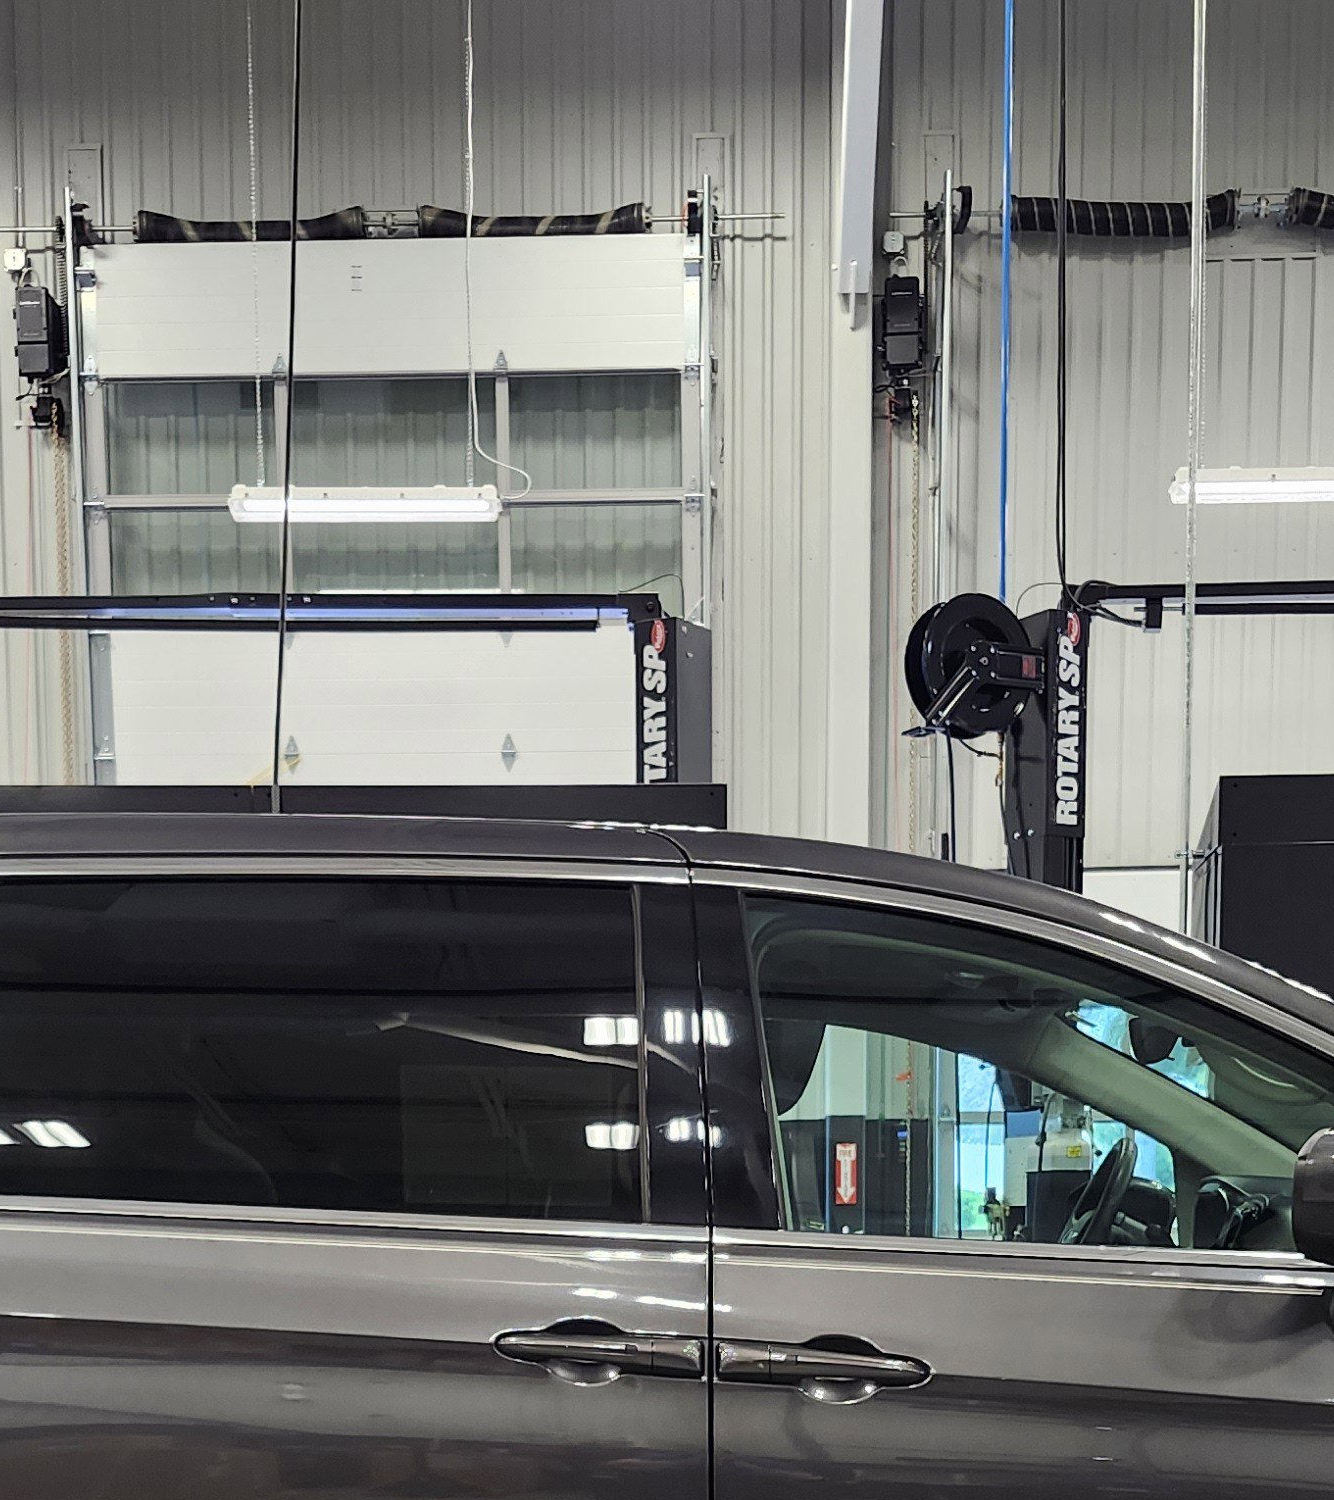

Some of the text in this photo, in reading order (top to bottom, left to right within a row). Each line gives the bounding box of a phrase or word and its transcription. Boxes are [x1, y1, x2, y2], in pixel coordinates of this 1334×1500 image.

[643, 644, 667, 694] SP
[1058, 635, 1080, 687] SP
[643, 697, 667, 785] TARY
[1055, 686, 1080, 826] ROTARY
